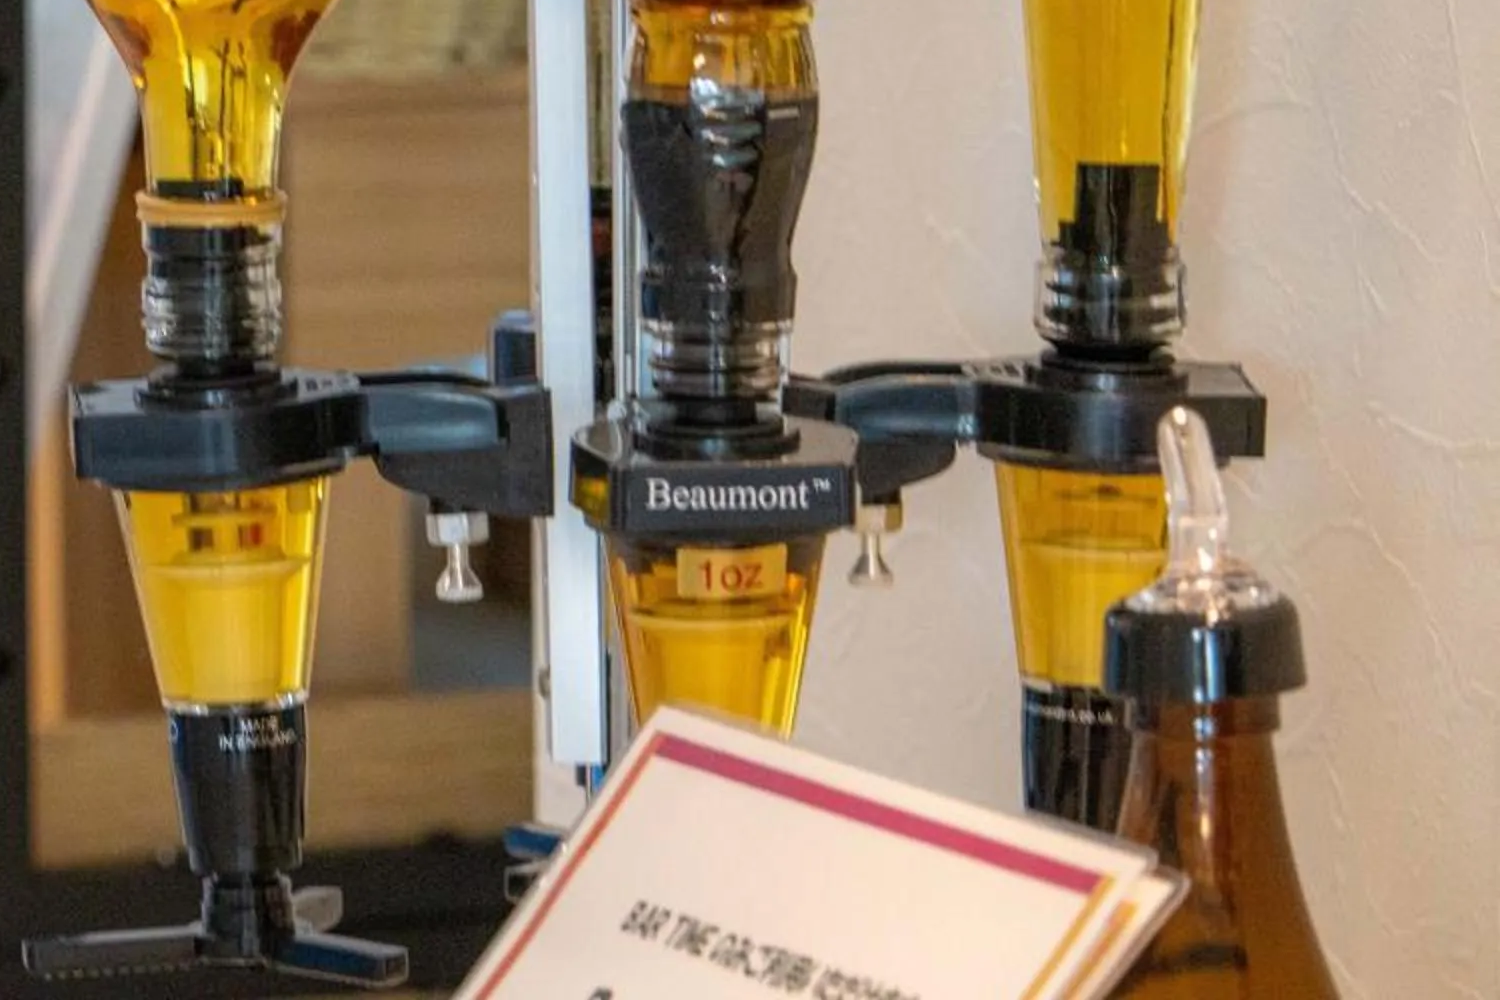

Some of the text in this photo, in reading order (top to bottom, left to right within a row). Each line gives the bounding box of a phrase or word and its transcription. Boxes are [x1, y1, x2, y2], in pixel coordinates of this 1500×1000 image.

[645, 477, 810, 511] Beaumont
[219, 733, 234, 751] IN
[620, 899, 672, 941] BAR
